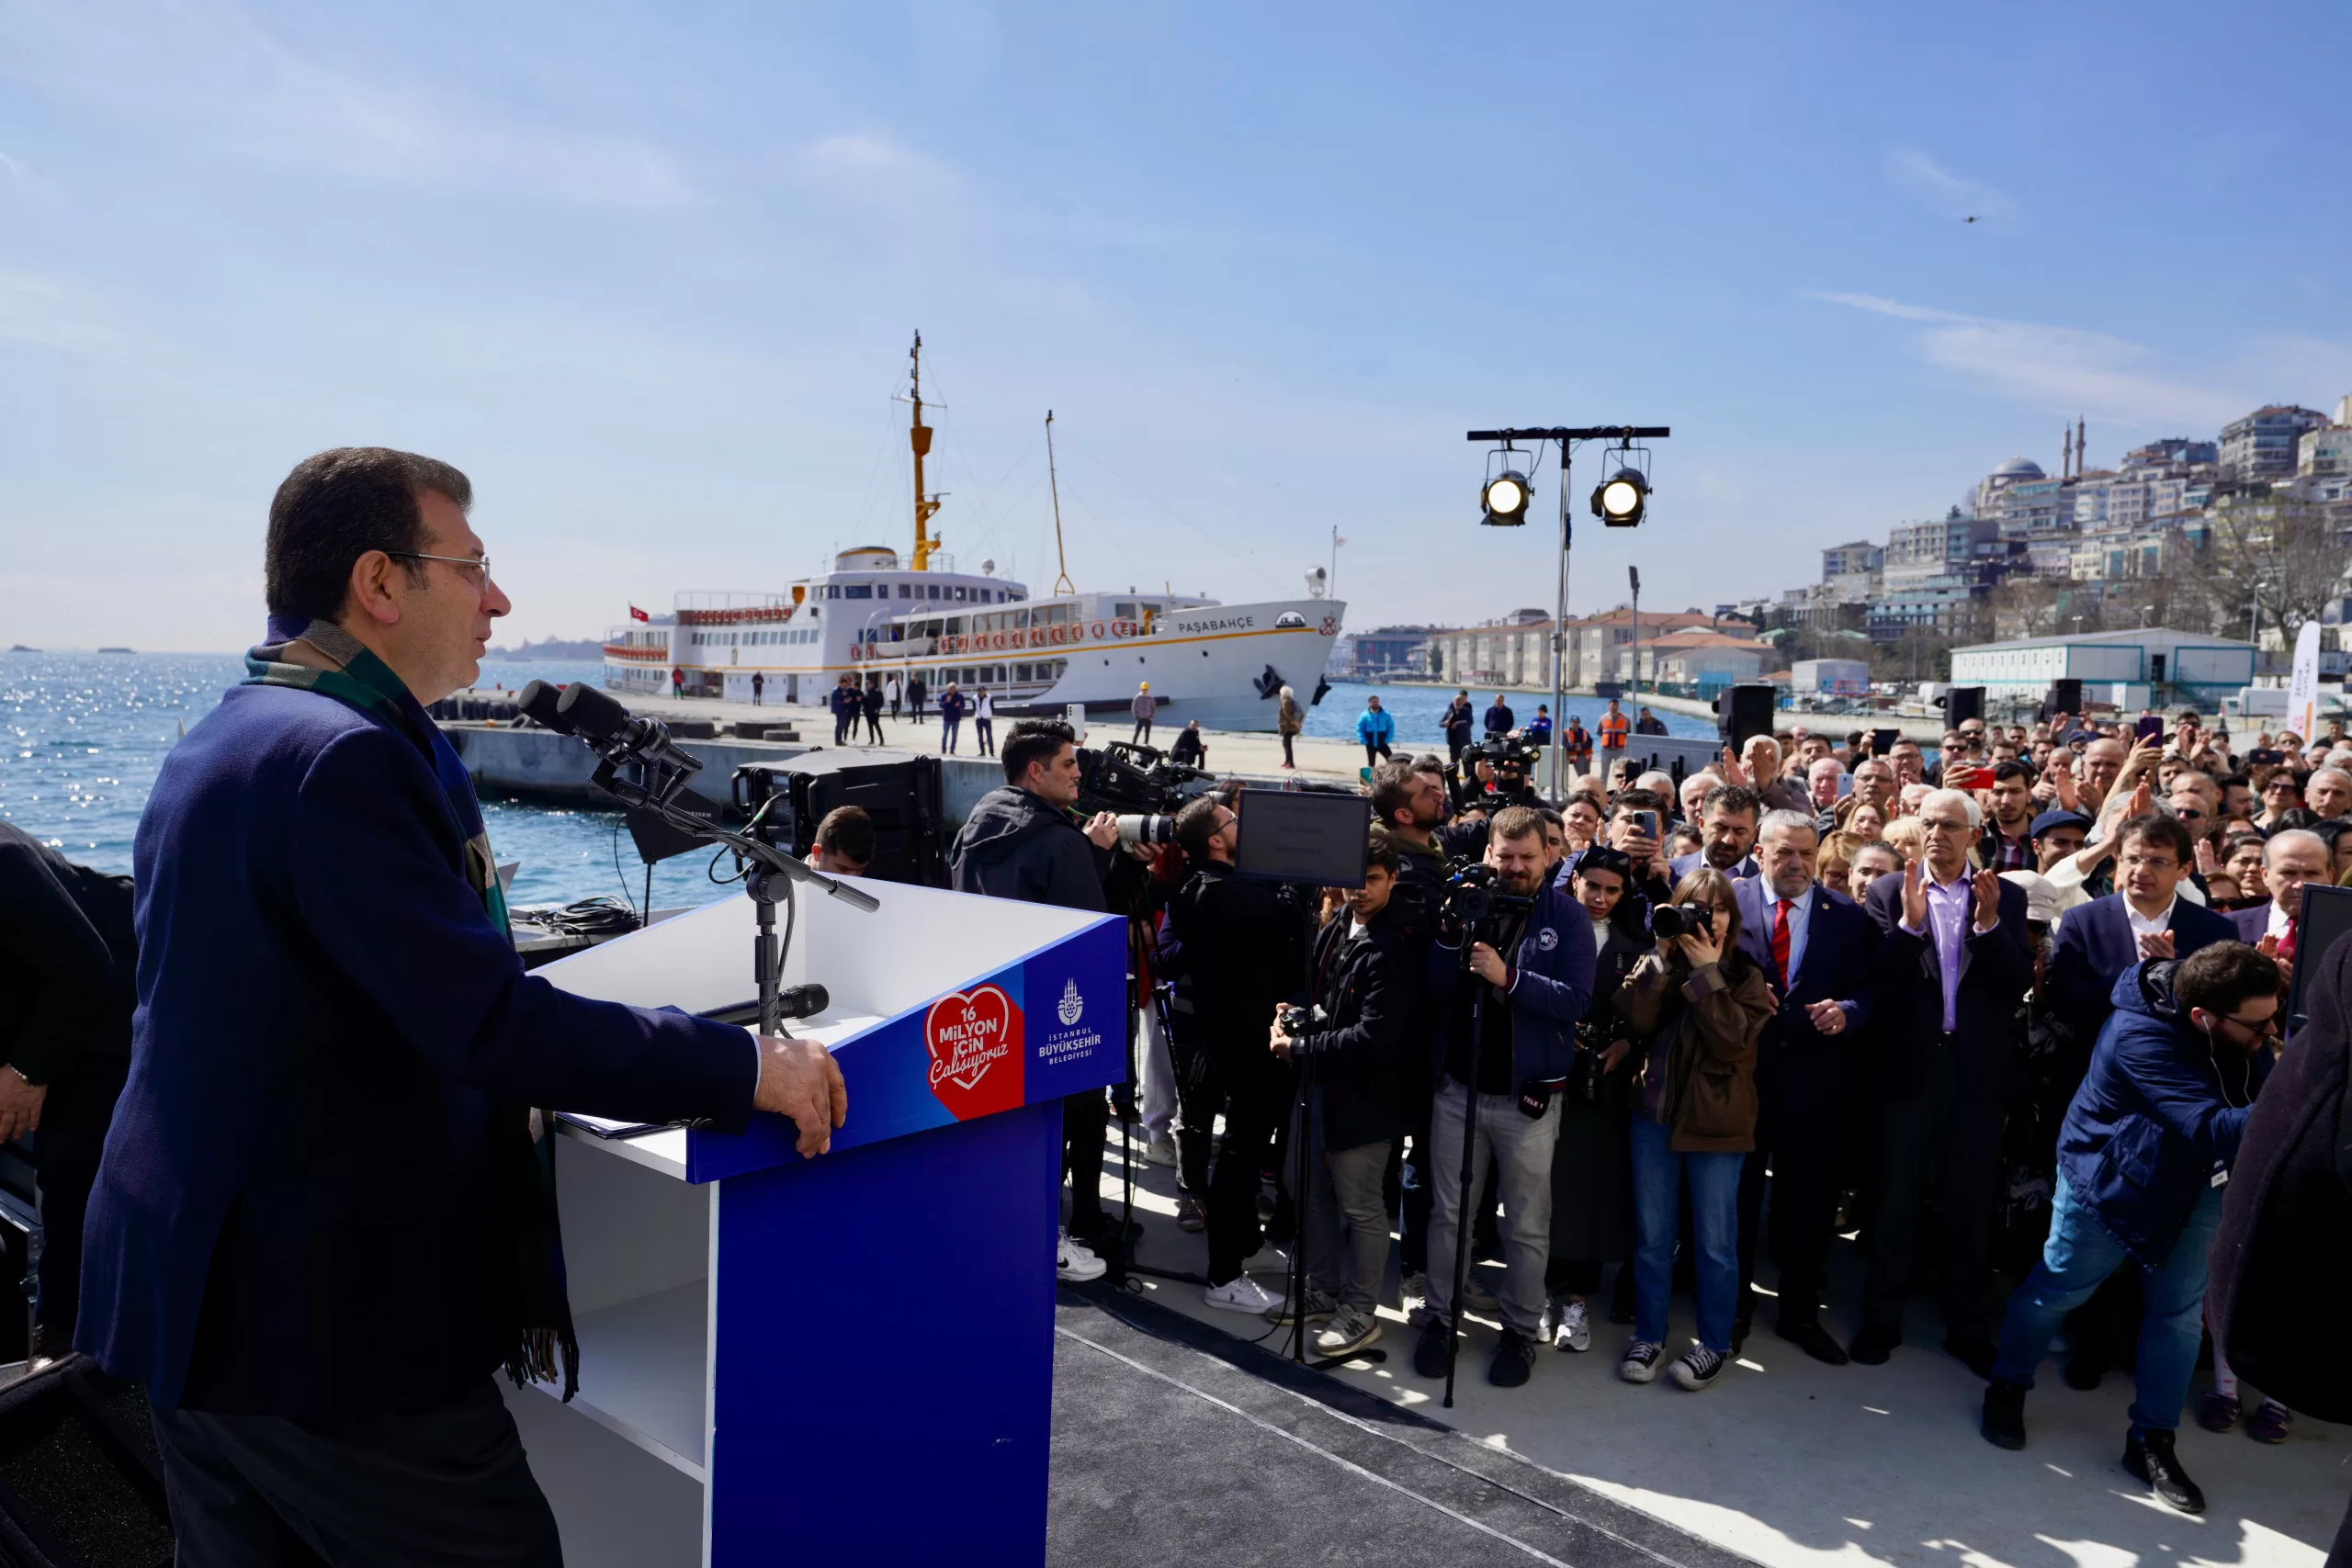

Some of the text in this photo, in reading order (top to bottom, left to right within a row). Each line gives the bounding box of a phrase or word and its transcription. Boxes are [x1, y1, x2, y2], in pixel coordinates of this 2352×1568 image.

[1179, 616, 1254, 634] PAŞABAHÇE
[1109, 772, 1118, 783] 3
[960, 1006, 977, 1022] 16
[1048, 1027, 1092, 1042] İSTANBUL
[1039, 1033, 1102, 1057] BÜYÜKŞEHİR
[1048, 1049, 1092, 1066] BELEDİYESİ
[930, 1043, 1009, 1090] Çalışıyoruz
[1524, 1095, 1539, 1108] TELE
